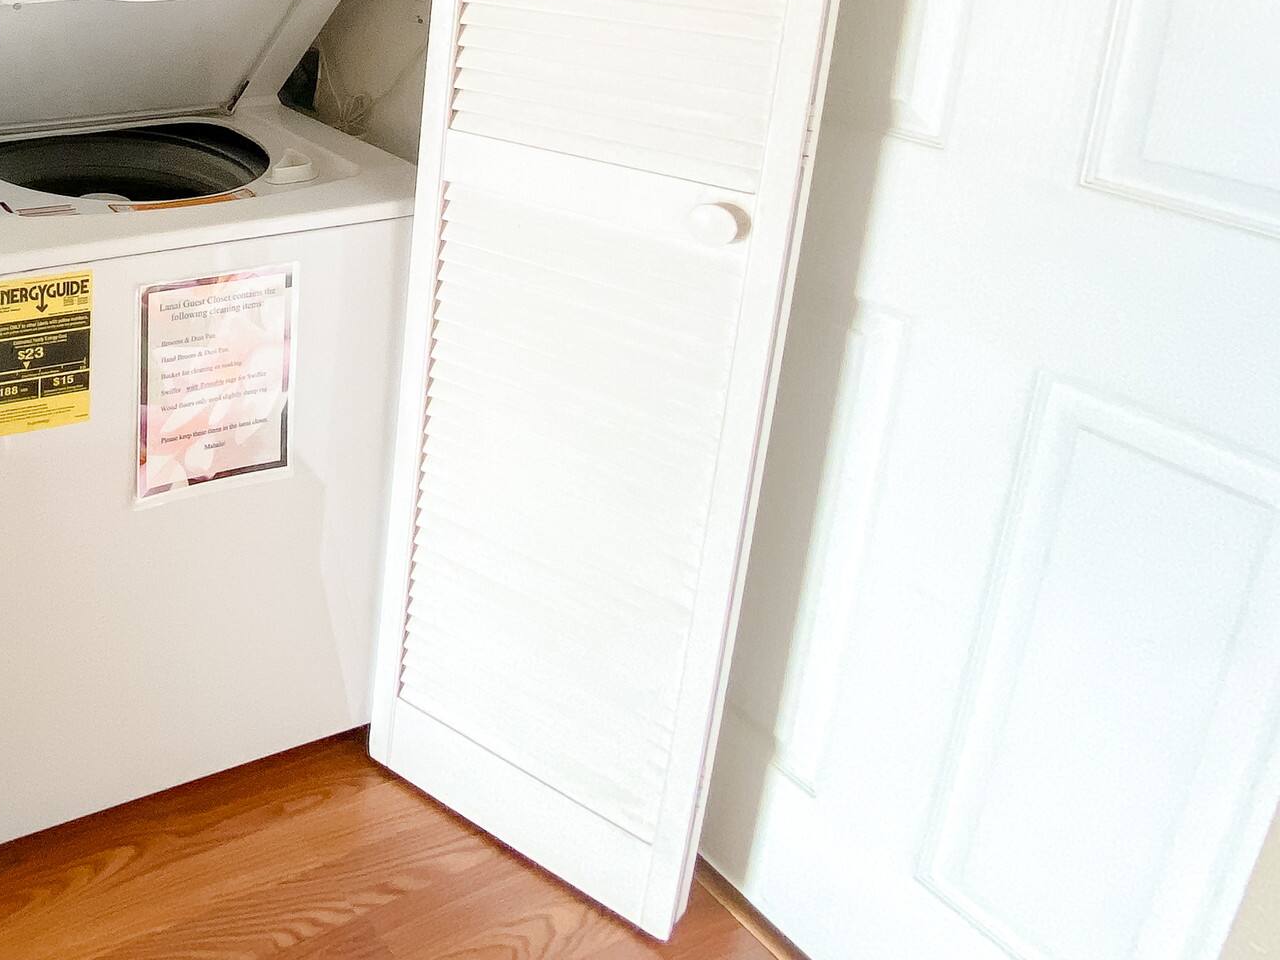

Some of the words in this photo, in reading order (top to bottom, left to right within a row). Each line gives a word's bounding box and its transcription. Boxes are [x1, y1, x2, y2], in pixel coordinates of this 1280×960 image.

[159, 301, 181, 311] Lanai
[183, 299, 205, 308] Guest
[207, 295, 231, 305] Closet
[170, 309, 208, 321] following
[17, 346, 44, 360] $23
[52, 375, 75, 387] $15
